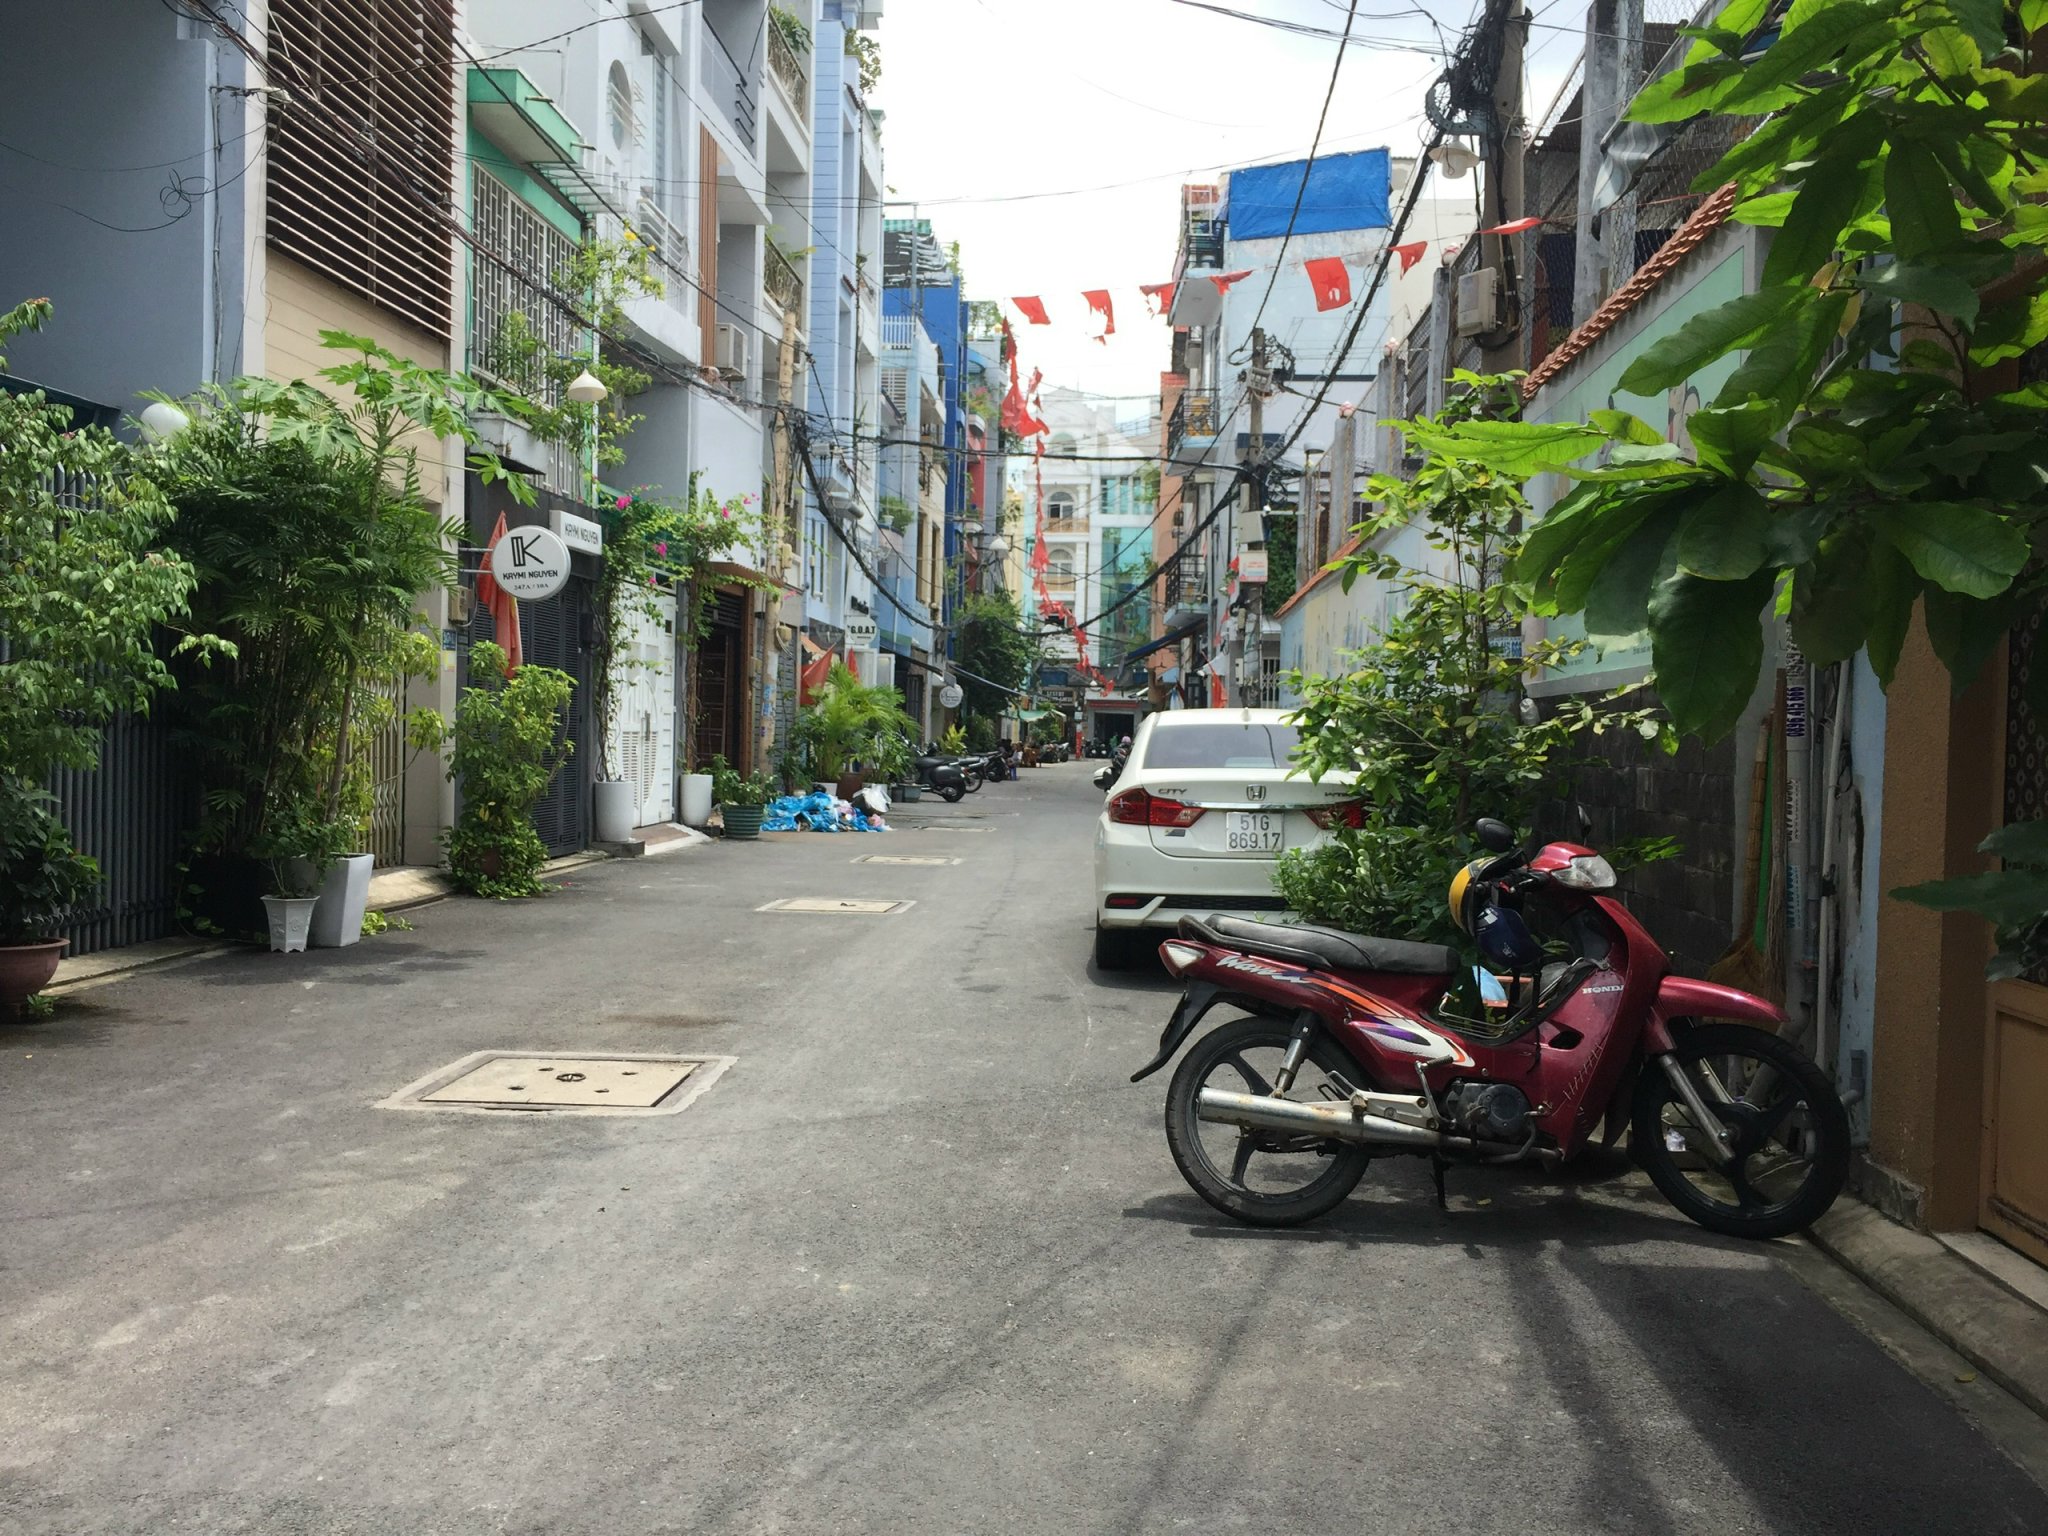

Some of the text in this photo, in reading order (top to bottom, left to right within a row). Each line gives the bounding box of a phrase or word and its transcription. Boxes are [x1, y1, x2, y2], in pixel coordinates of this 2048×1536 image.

[528, 570, 558, 578] NGUYEN
[1240, 814, 1270, 831] 51G
[1229, 831, 1281, 849] 869.17
